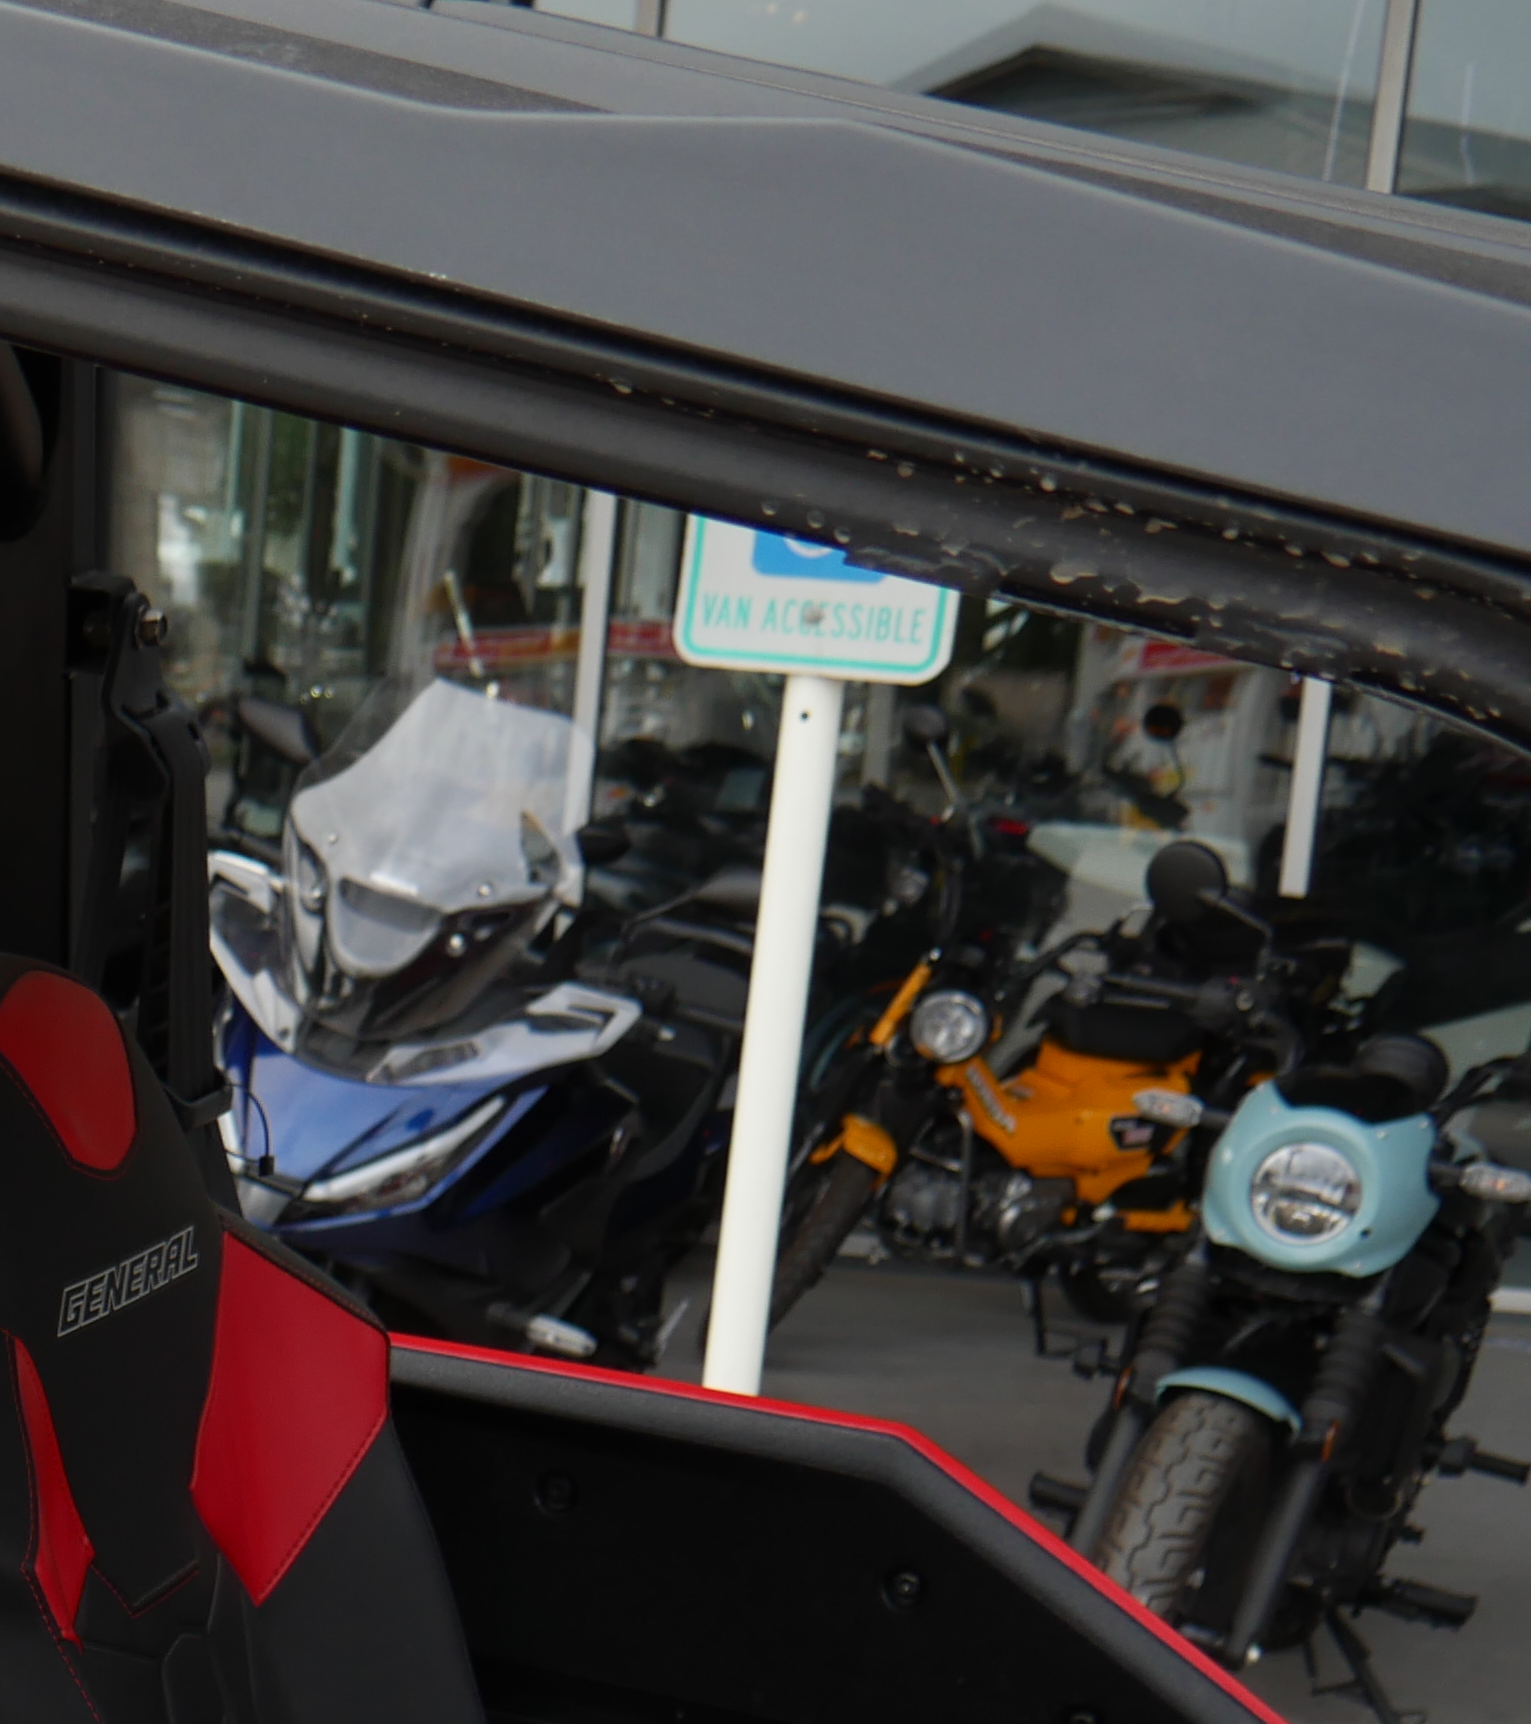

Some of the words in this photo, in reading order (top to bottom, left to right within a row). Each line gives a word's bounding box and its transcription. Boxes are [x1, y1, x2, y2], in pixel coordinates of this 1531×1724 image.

[701, 591, 751, 631] VAN
[760, 596, 926, 645] ACCESSIBLE
[56, 1224, 199, 1338] GENERAL
